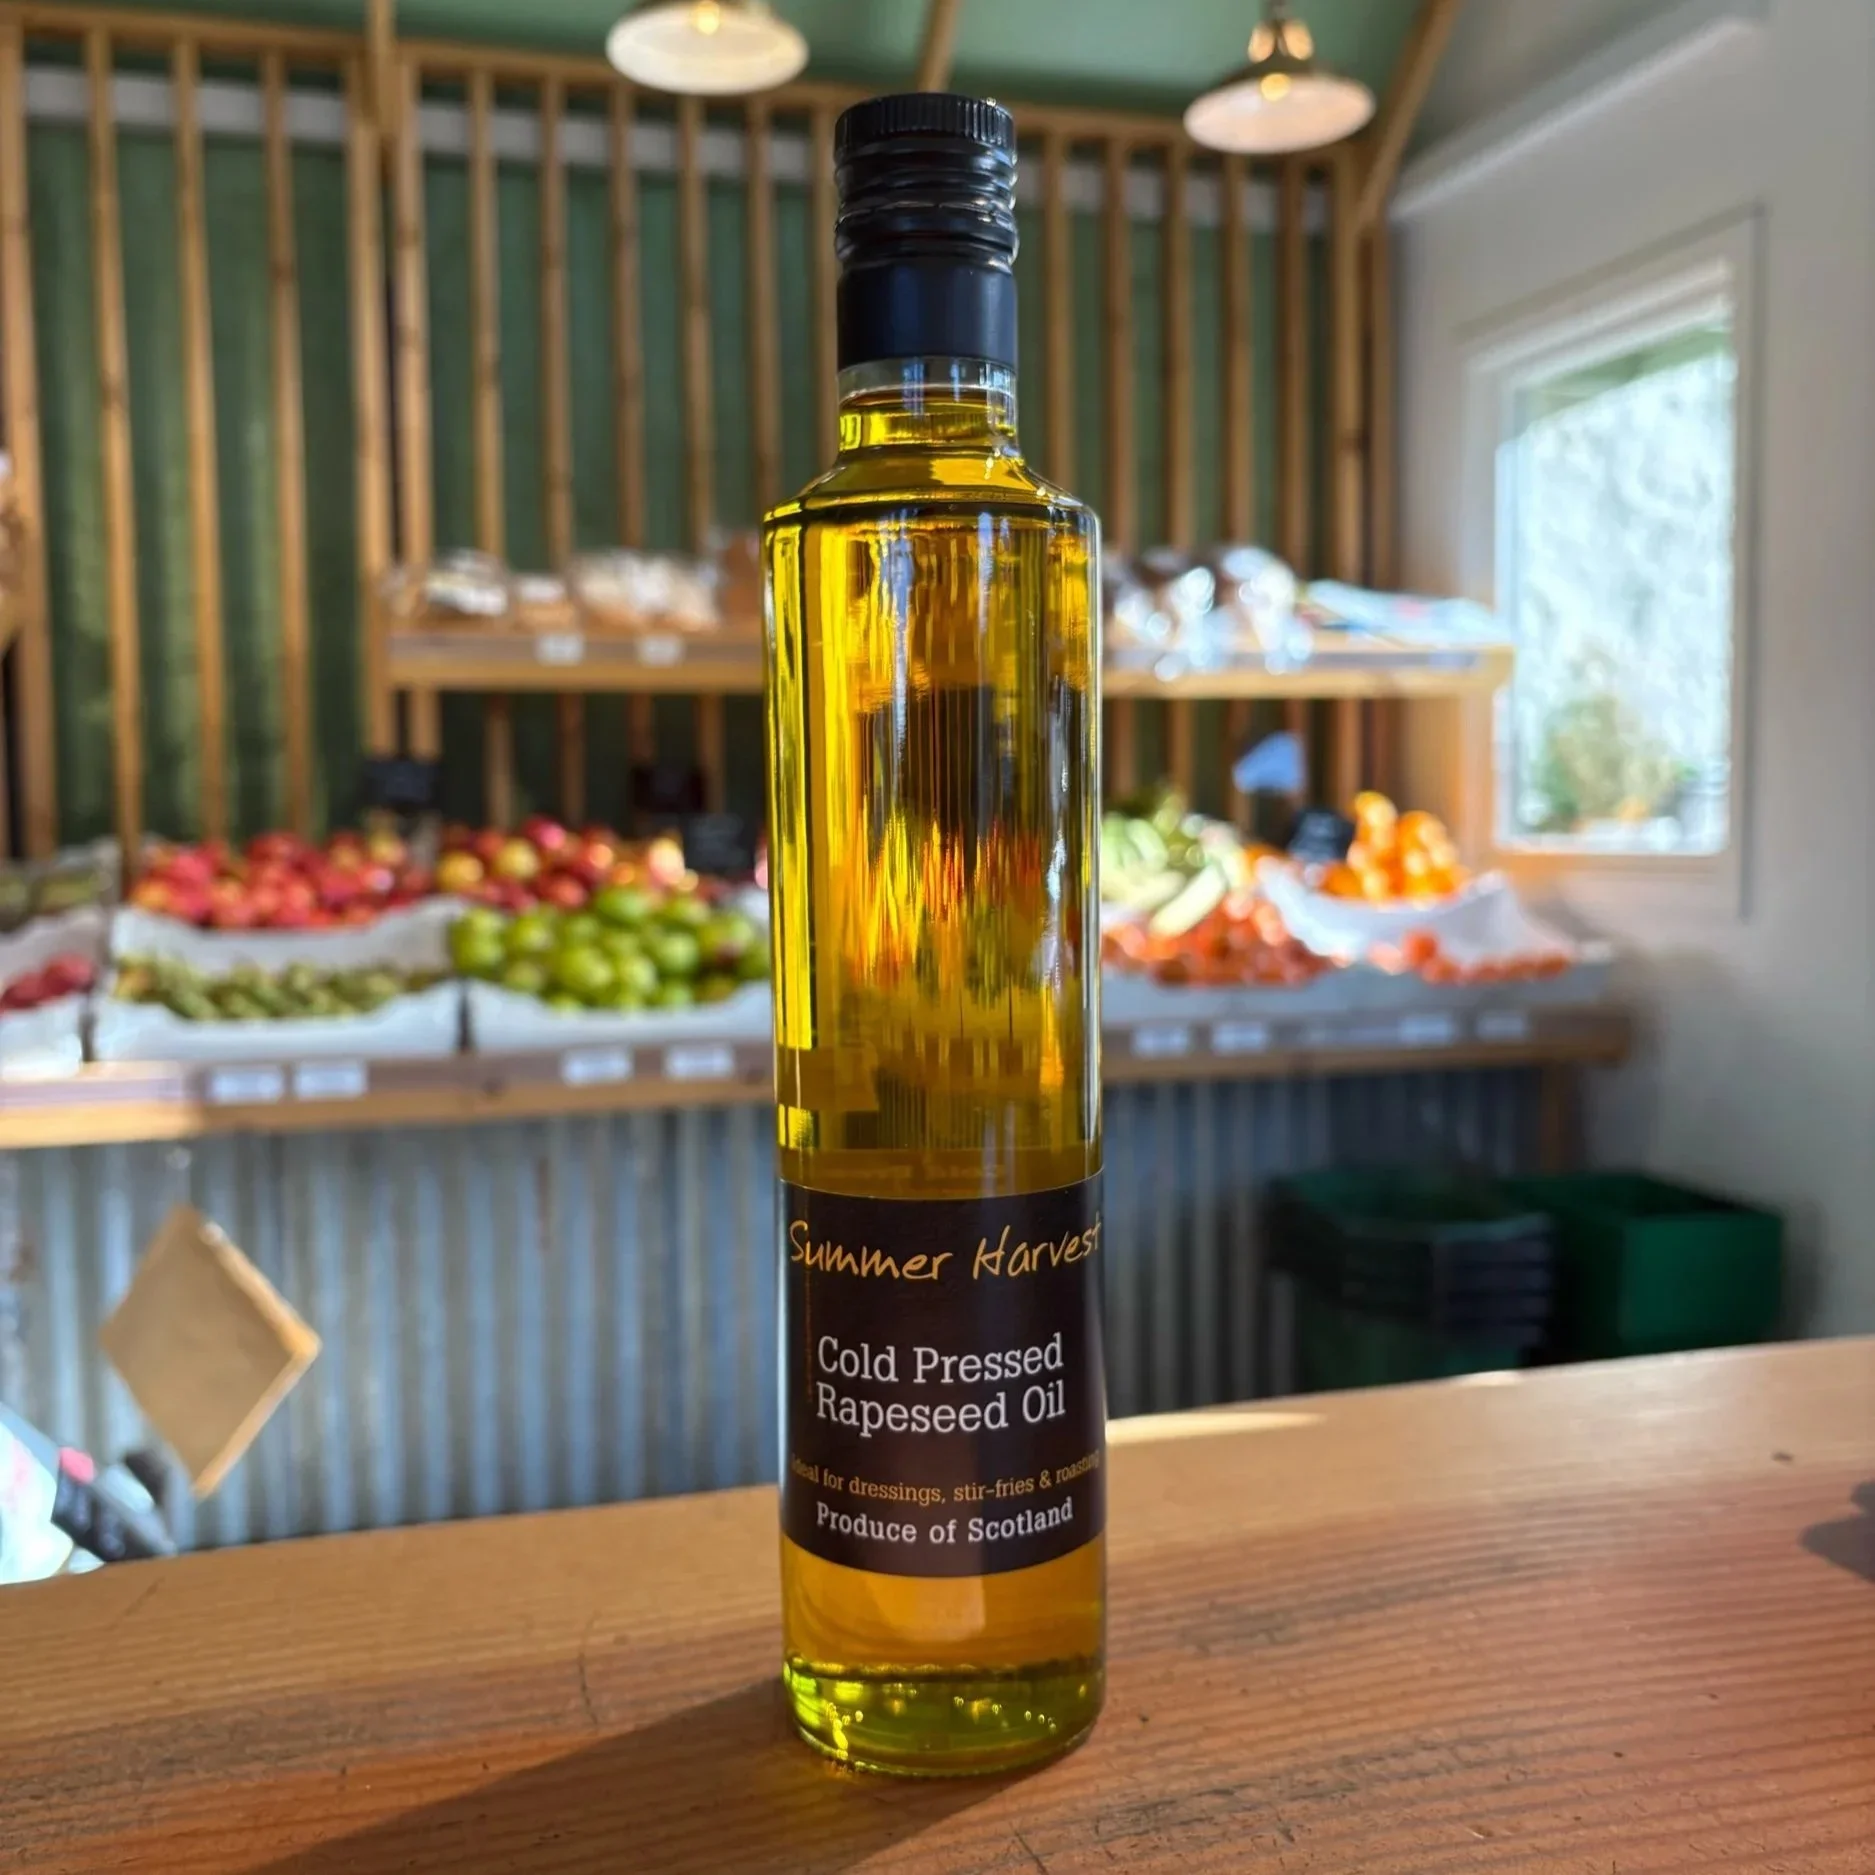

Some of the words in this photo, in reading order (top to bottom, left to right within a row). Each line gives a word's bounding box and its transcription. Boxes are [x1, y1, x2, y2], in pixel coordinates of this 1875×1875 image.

[789, 1220, 952, 1280] Summer
[973, 1211, 1102, 1280] Harvest
[818, 1335, 899, 1383] Cold
[912, 1331, 1064, 1384] Pressed
[816, 1382, 1008, 1438] Rapeseed
[1022, 1380, 1066, 1424] Oil
[822, 1468, 844, 1491] for
[848, 1475, 946, 1506] dressings,
[953, 1477, 1035, 1501] stir-fries
[1039, 1469, 1052, 1489] &
[816, 1501, 918, 1543] Produce
[928, 1518, 957, 1544] of
[967, 1497, 1074, 1543] Scotland
